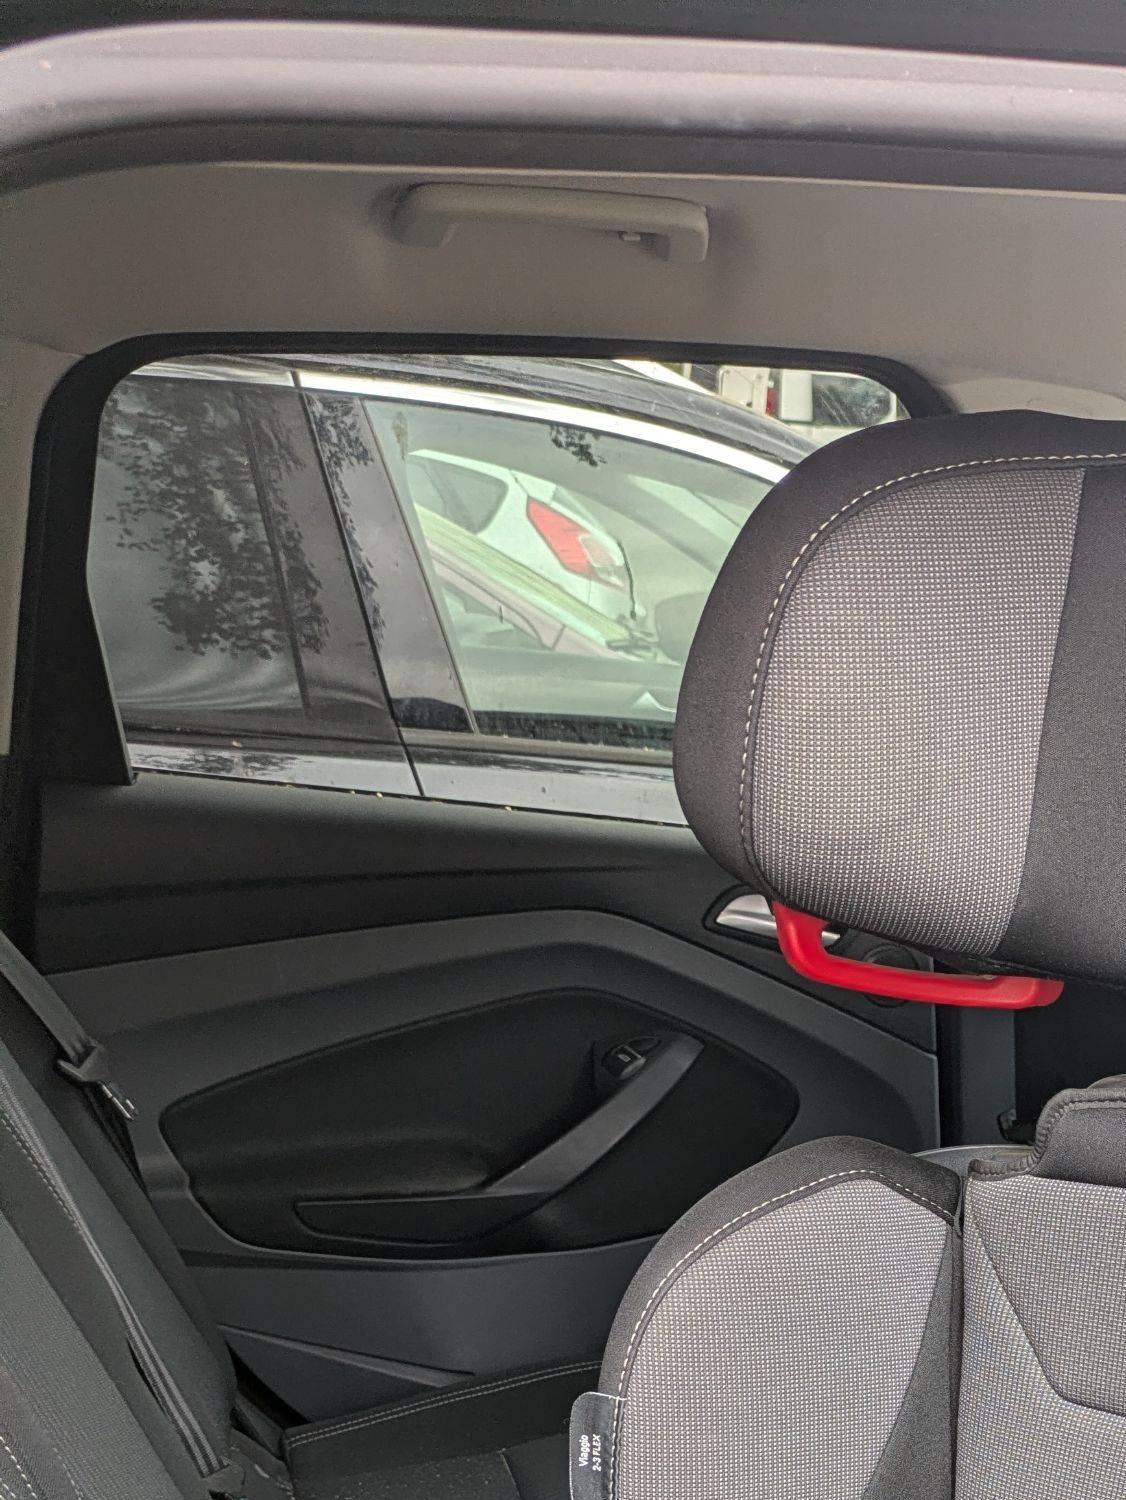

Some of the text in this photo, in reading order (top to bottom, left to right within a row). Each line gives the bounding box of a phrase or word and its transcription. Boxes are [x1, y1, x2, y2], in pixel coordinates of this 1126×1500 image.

[578, 1434, 590, 1467] Viaggio
[591, 1433, 602, 1472] 2-3 FLEX
